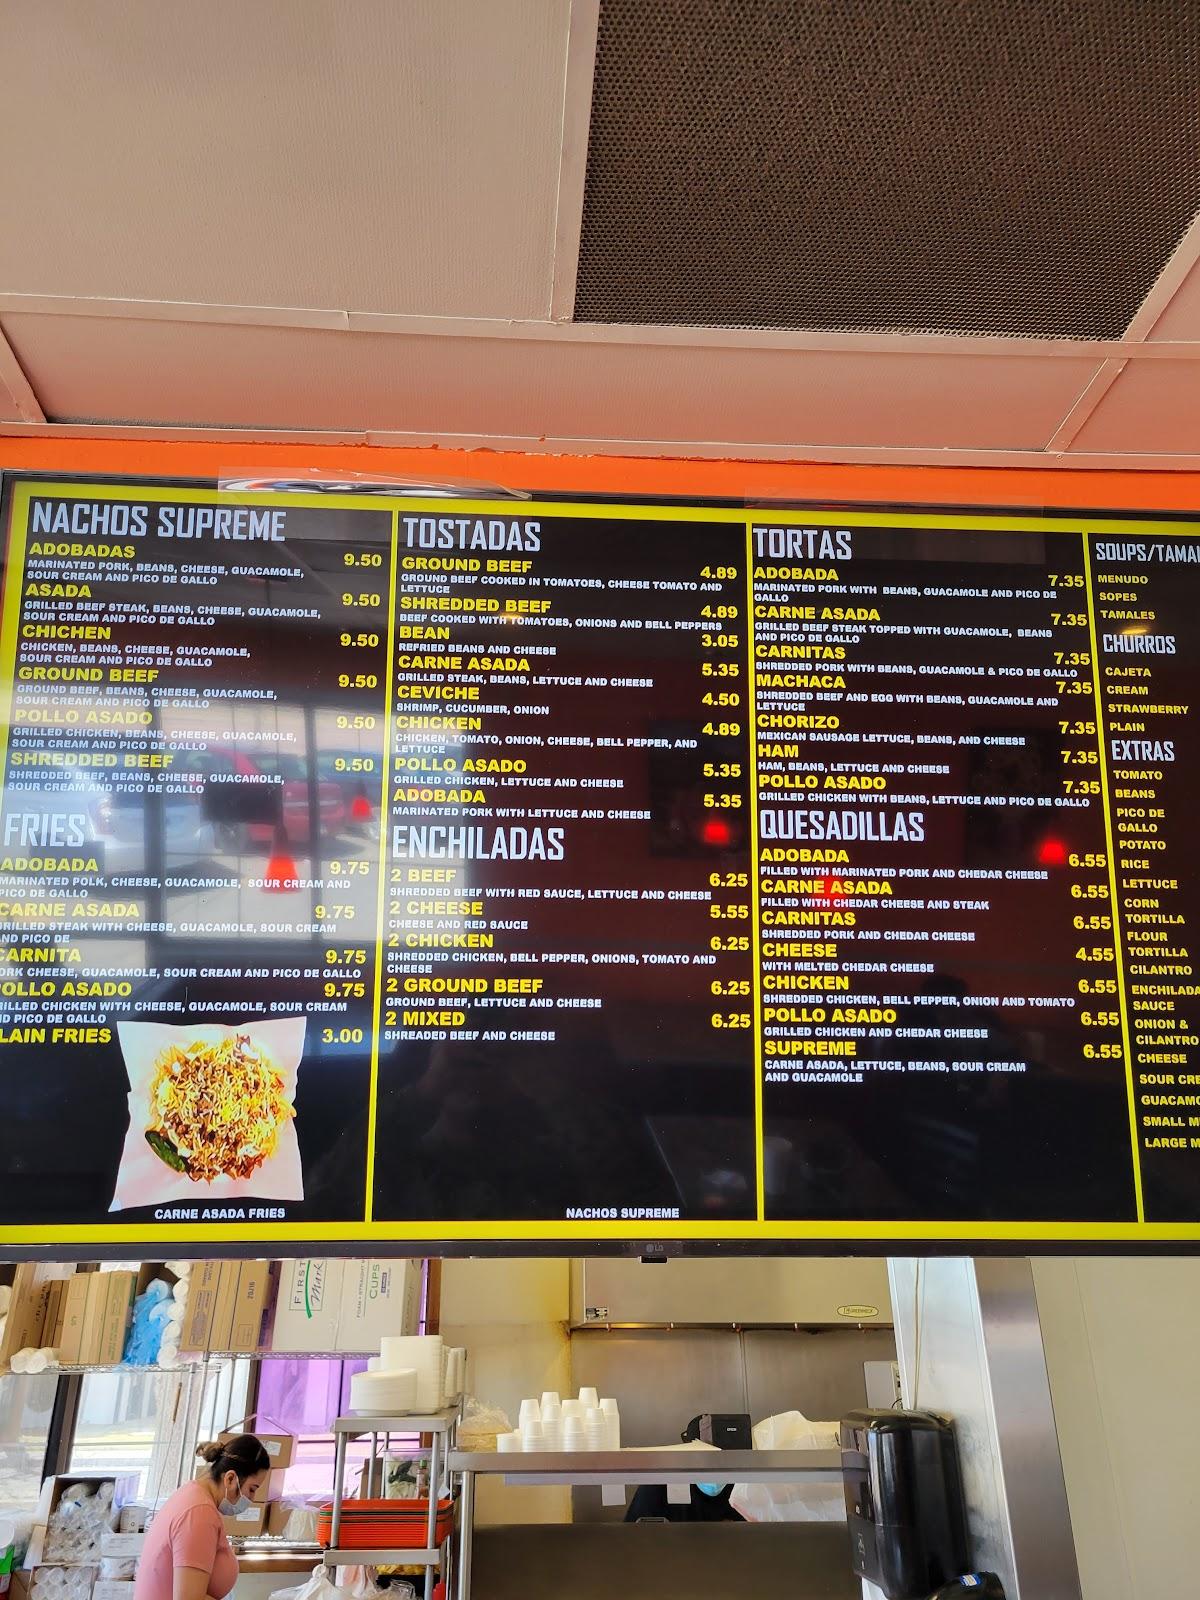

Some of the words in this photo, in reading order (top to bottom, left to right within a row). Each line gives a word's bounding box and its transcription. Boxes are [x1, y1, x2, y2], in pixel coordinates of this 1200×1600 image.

[32, 501, 148, 536] NACHOS
[157, 506, 286, 541] SUPREME
[403, 517, 540, 551] TOSTADAS
[29, 542, 135, 558] ADOBADAS
[752, 528, 852, 560] TORTAS
[344, 553, 381, 566] 9.50
[401, 556, 480, 571] GROUND
[486, 559, 532, 573] BEEF
[27, 559, 95, 569] MARINATED
[98, 561, 133, 571] PORK,
[136, 563, 177, 572] BEANS,
[180, 564, 228, 574] CHEESE,
[231, 566, 304, 576] GUACAMOLE,
[700, 566, 737, 579] 4.89
[27, 570, 59, 579] SOUR
[61, 571, 102, 581] CREAM
[104, 572, 129, 581] AND
[132, 574, 159, 582] PICO
[162, 574, 177, 583] DE
[180, 575, 217, 584] GALLO
[401, 573, 447, 587] GROUND
[450, 574, 477, 583] BEEF
[480, 575, 526, 585] COOKED
[528, 577, 540, 586] IN
[543, 577, 605, 588] TOMATOES,
[607, 579, 649, 589] CHEESE
[652, 581, 697, 590] TOMATO
[700, 582, 722, 591] AND
[1097, 574, 1148, 584] MENUDO
[400, 584, 450, 593] LETTUCE
[1099, 592, 1137, 601] SOPES
[1100, 610, 1155, 619] TAMALES
[22, 624, 111, 639] CHICHEN
[399, 625, 449, 639] BEAN
[340, 633, 378, 647] 9.50
[701, 634, 738, 647] 3.05
[1102, 631, 1175, 654] CHURROS
[398, 642, 445, 652] REFRIED
[448, 643, 484, 653] BEANS
[487, 645, 510, 654] AND
[513, 645, 556, 655] CHEESE
[1105, 666, 1151, 676] CAJETA
[397, 685, 479, 699] CEVICHE
[1106, 685, 1148, 694] CREAM
[701, 692, 739, 706] 4.50
[396, 702, 442, 712] SHRIMP,
[445, 703, 510, 714] CUCUMBER,
[513, 705, 549, 714] ONION
[1108, 703, 1188, 714] STRAWBERRY
[757, 714, 839, 728] CHORIZO
[1058, 721, 1095, 734] 7.35
[1109, 722, 1144, 731] PLAIN
[757, 731, 806, 740] MEXICAN
[809, 732, 859, 742] SAUSAGE
[862, 733, 914, 743] LETTUCE,
[916, 734, 956, 744] BEANS,
[958, 735, 980, 744] AND
[983, 736, 1025, 745] CHEESE
[758, 743, 798, 758] HAM
[1060, 750, 1098, 764] 7.35
[1111, 739, 1174, 762] EXTRAS
[758, 761, 785, 771] HAM,
[788, 762, 827, 771] BEANS,
[830, 762, 879, 772] LETTUCE
[881, 764, 904, 773] AND
[907, 764, 949, 774] CHEESE
[1112, 769, 1162, 780] TOMATO
[1114, 789, 1155, 798] BEANS
[1116, 807, 1145, 817] PICO
[1148, 808, 1165, 817] DE
[3, 812, 86, 847] FRIES
[760, 809, 924, 841] QUESADILLAS
[1117, 822, 1157, 832] GALLO
[392, 825, 564, 863] ENCHILADAS
[1119, 839, 1166, 849] POTATO
[0, 857, 98, 871] ADOBADA
[330, 861, 369, 875] 9.75
[1120, 859, 1149, 869] RICE
[0, 876, 69, 889] MARINATED
[72, 876, 107, 886] POLK,
[111, 877, 161, 886] CHEESE,
[164, 878, 242, 891] GUACAMOLE,
[247, 878, 280, 888] SOUR
[283, 879, 323, 888] CREAM
[326, 879, 350, 889] AND
[1122, 878, 1177, 889] LETTUCE
[389, 900, 400, 914] 2
[406, 901, 482, 915] CHEESE
[1124, 898, 1159, 908] CORN
[710, 904, 748, 918] 5.55
[761, 910, 855, 925] CARNITAS
[388, 919, 433, 928] CHEESE
[436, 919, 460, 928] AND
[464, 920, 486, 929] RED
[489, 920, 528, 929] SAUCE
[1073, 915, 1111, 929] 6.55
[1124, 913, 1185, 923] TORTILLA
[761, 929, 821, 939] SHREDDED
[823, 930, 854, 939] PORK
[857, 930, 881, 939] AND
[883, 930, 929, 940] CHEDAR
[931, 931, 975, 941] CHEESE
[1126, 931, 1167, 941] FLOUR
[1127, 947, 1188, 957] TORTILLA
[1129, 964, 1192, 975] CILANTRO
[1133, 1000, 1174, 1011] SAUCE
[385, 1011, 396, 1025] 2
[403, 1011, 465, 1026] MIXED
[711, 1013, 750, 1028] 6.25
[1134, 1019, 1175, 1029] ONION
[1179, 1019, 1188, 1029] &
[0, 1028, 45, 1043] LAIN
[52, 1028, 111, 1043] FRIES
[322, 1028, 362, 1043] 3.00
[384, 1030, 446, 1040] SHREADED
[449, 1030, 479, 1040] BEEF
[482, 1030, 506, 1040] AND
[509, 1031, 555, 1040] CHEESE
[1135, 1034, 1199, 1045] CILANTRO
[764, 1040, 856, 1055] SUPREME
[1083, 1044, 1122, 1058] 6.55
[1137, 1053, 1187, 1063] CHEESE
[764, 1059, 803, 1069] CARNE
[806, 1060, 847, 1070] ASADA,
[850, 1060, 905, 1070] LETTUCE,
[907, 1061, 949, 1071] BEANS,
[952, 1061, 983, 1071] SOUR
[986, 1062, 1025, 1071] CREAM
[764, 1072, 789, 1081] AND
[791, 1072, 863, 1082] GUACAMOLE
[1139, 1074, 1174, 1084] SOUR
[1143, 1116, 1185, 1126] SMALL
[1144, 1137, 1187, 1147] LARGE
[154, 1208, 198, 1219] CARNE
[201, 1208, 245, 1218] ASADA
[248, 1208, 285, 1218] FRIES
[566, 1207, 617, 1218] NACHOS
[620, 1207, 679, 1218] SUPREME
[294, 1261, 306, 1304] FIRST
[310, 1263, 323, 1306] Mark
[369, 1263, 380, 1299] CUPS
